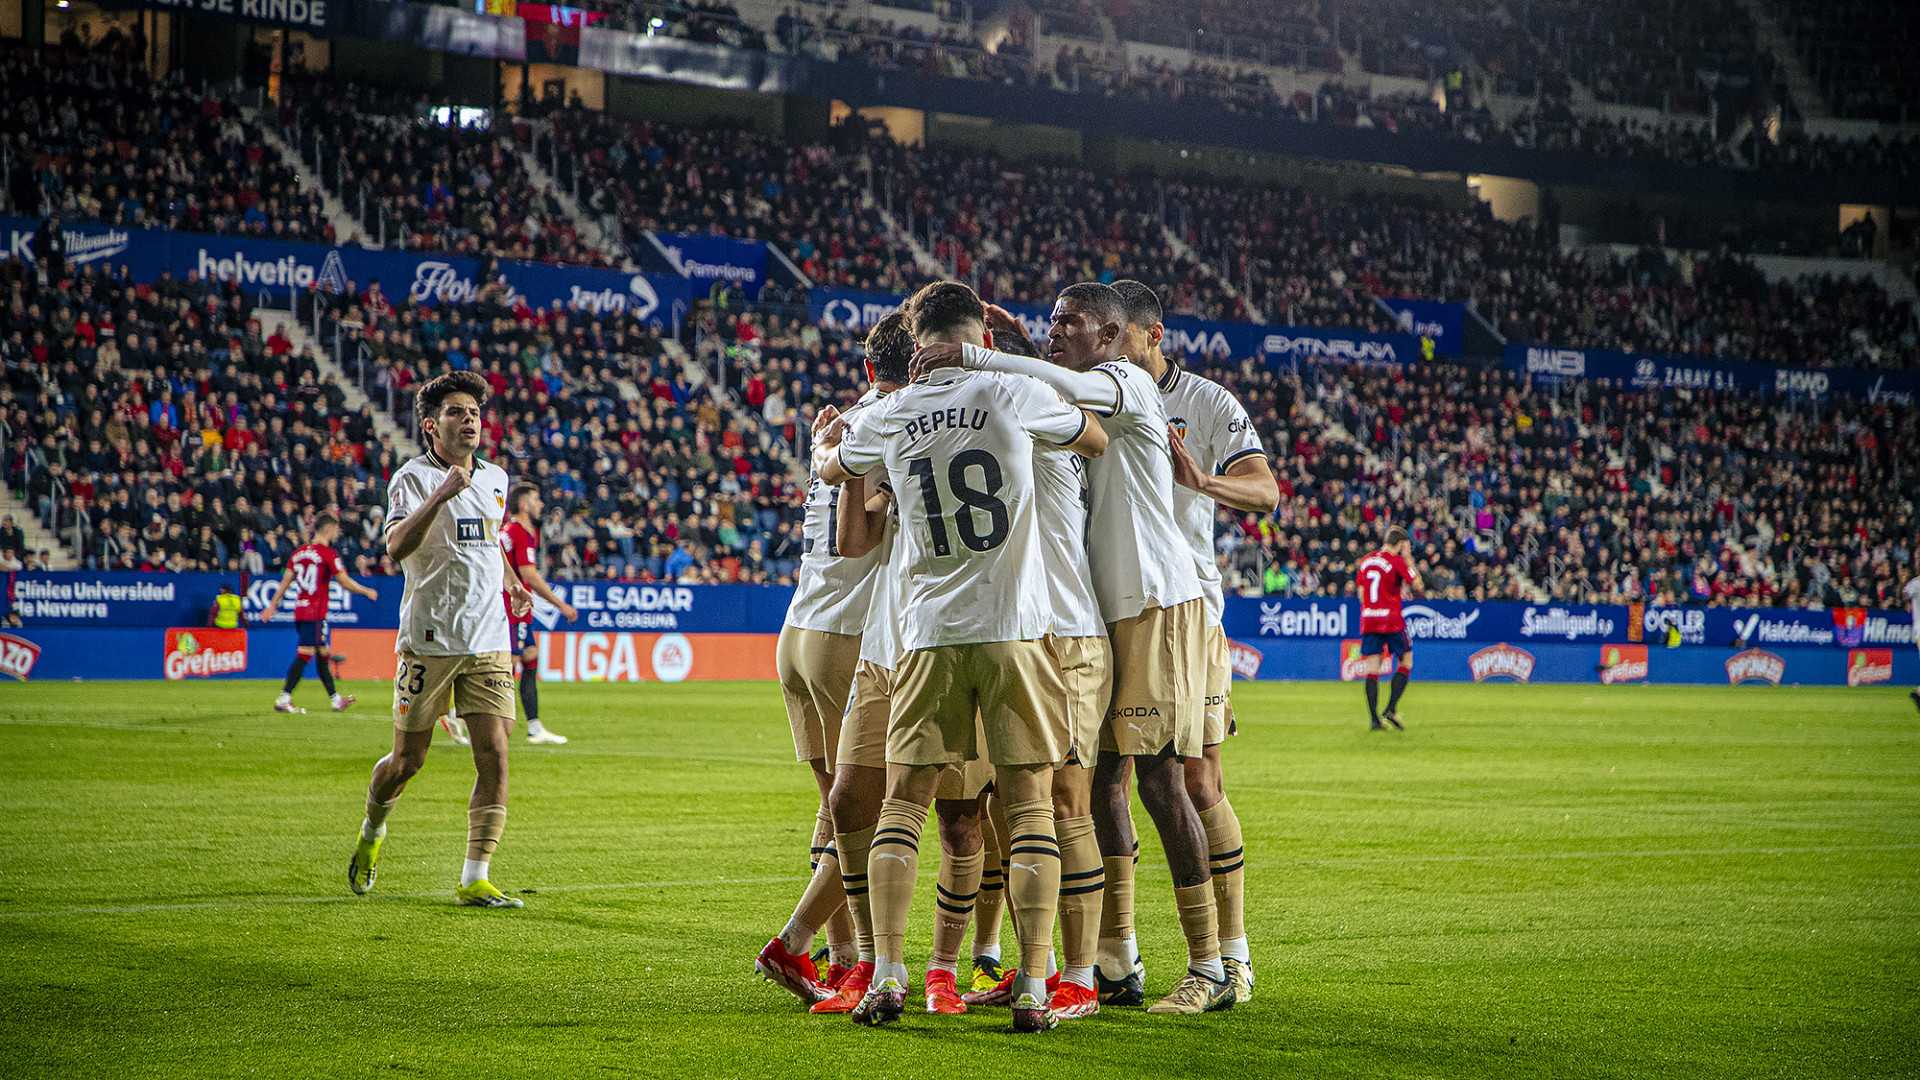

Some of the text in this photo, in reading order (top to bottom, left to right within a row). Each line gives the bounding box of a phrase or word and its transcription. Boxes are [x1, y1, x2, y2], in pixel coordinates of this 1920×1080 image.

[242, 0, 326, 26] RINDE
[198, 248, 315, 287] helvetia
[905, 407, 988, 442] PEPELU
[908, 449, 1009, 557] 18
[460, 523, 480, 537] TM
[14, 579, 175, 601] Clínica Universidad
[571, 585, 694, 612] EL SADAR
[1366, 569, 1381, 603] 7
[36, 600, 108, 618] Navarra
[1758, 619, 1809, 643] Halcón
[166, 648, 245, 680] Grefusa
[398, 661, 427, 695] 23
